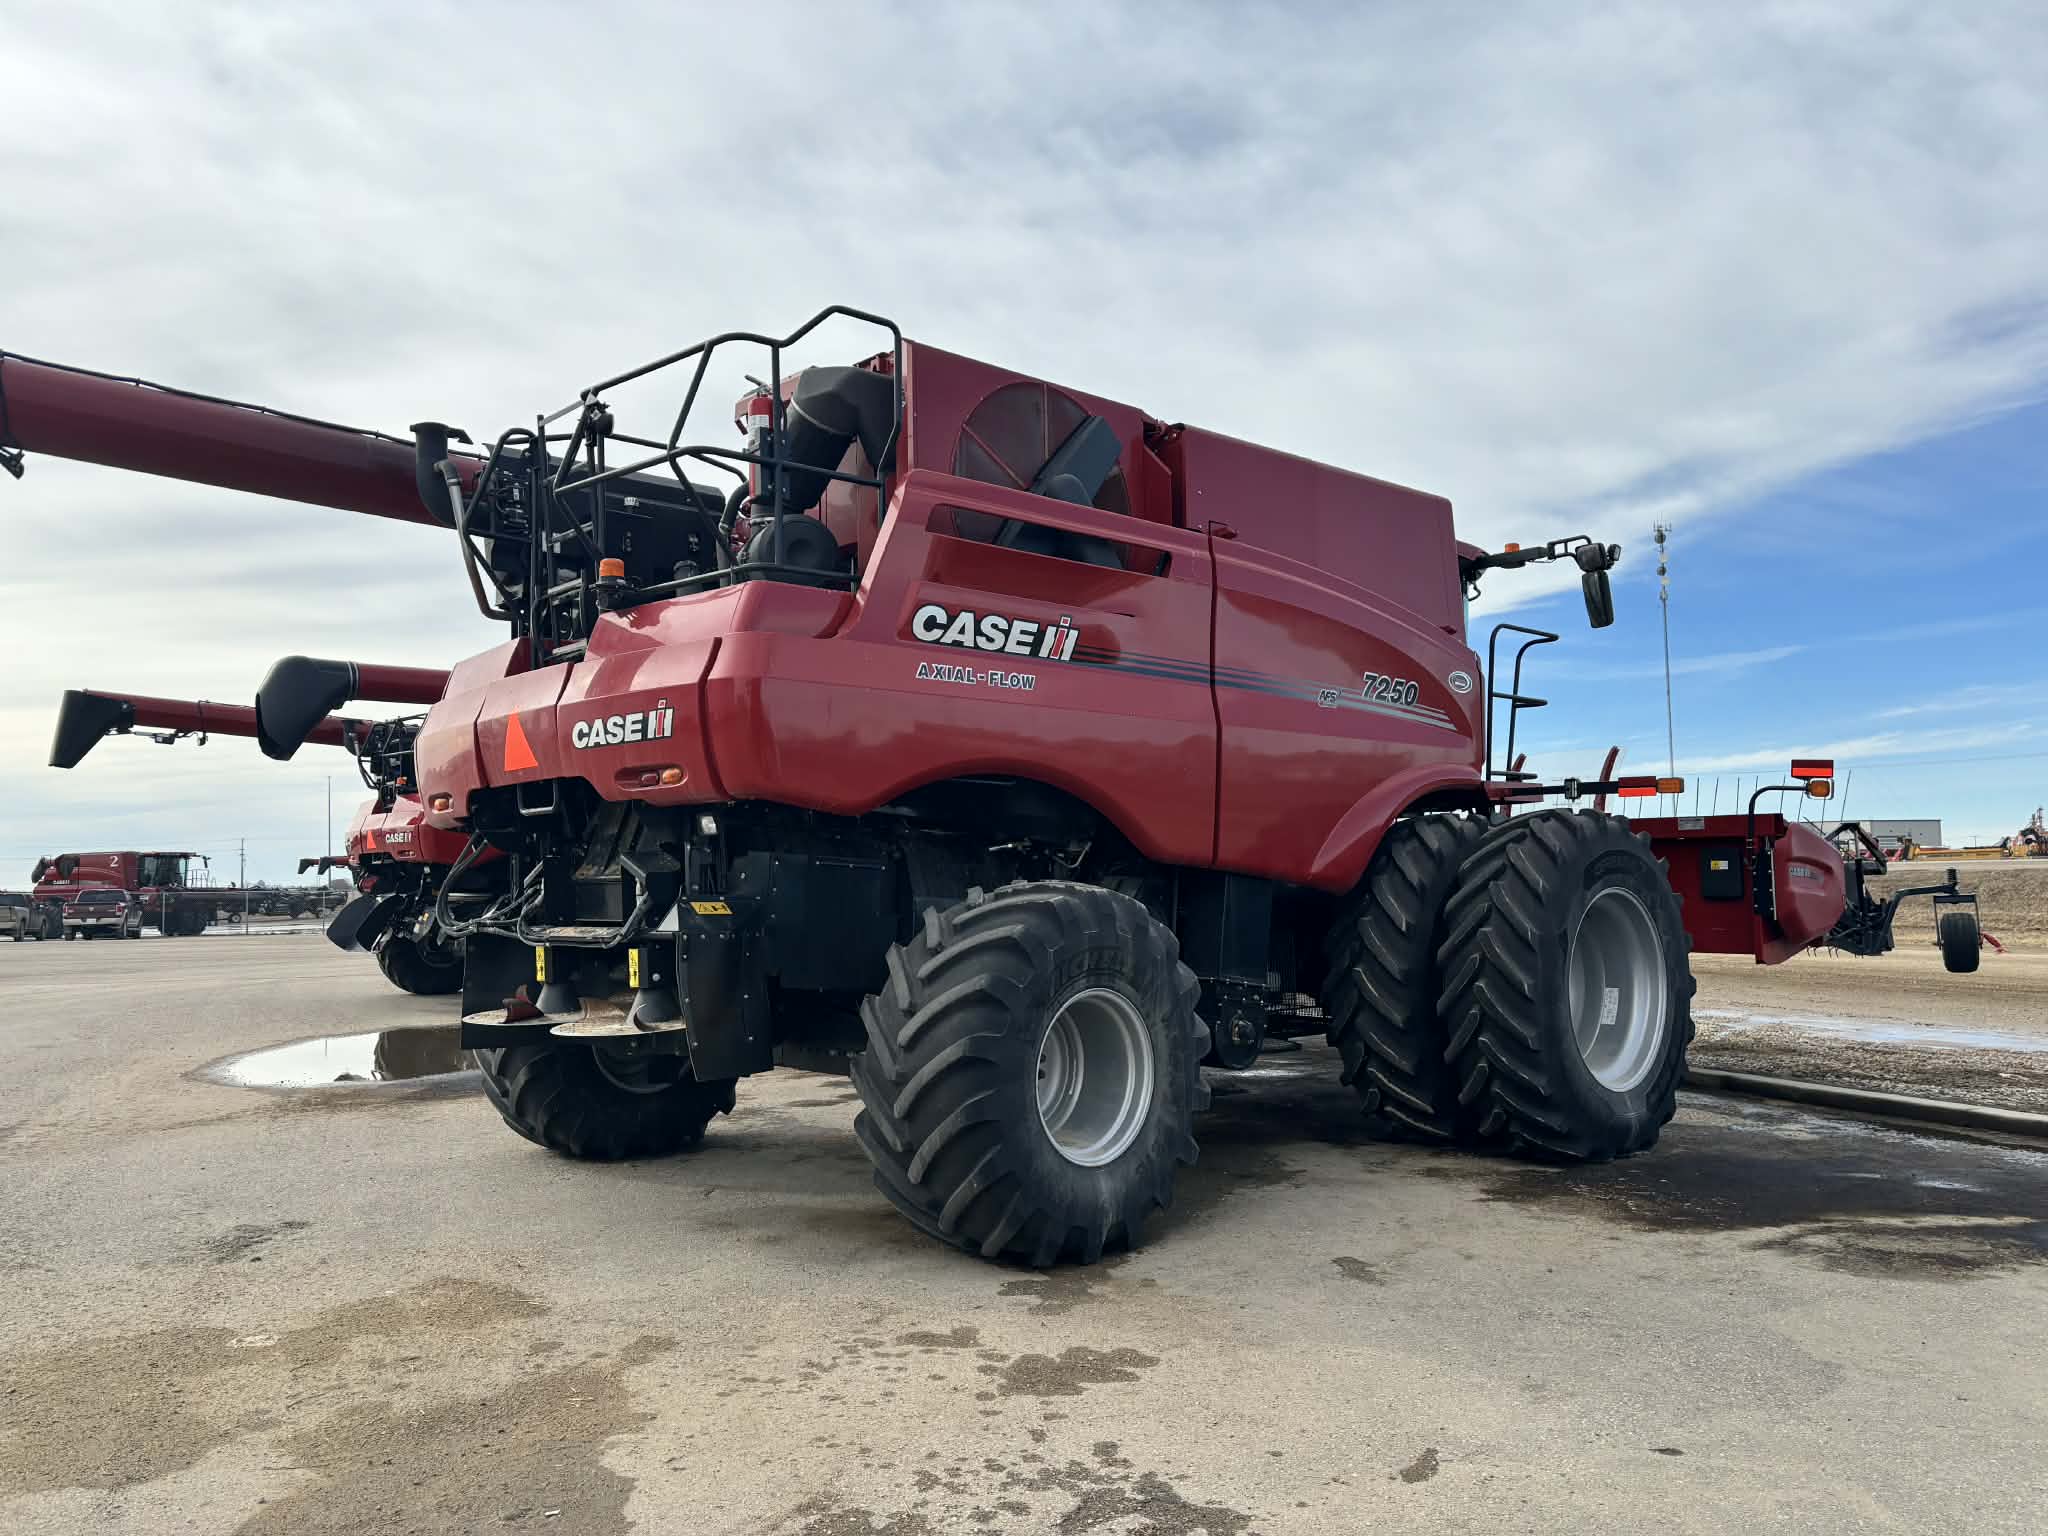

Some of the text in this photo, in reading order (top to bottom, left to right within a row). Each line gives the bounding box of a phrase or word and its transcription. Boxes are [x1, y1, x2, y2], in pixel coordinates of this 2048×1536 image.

[912, 605, 1038, 655] CASE
[1362, 672, 1419, 706] 7250
[572, 712, 644, 749] CASE
[385, 833, 404, 843] CASE
[109, 856, 119, 867] 2
